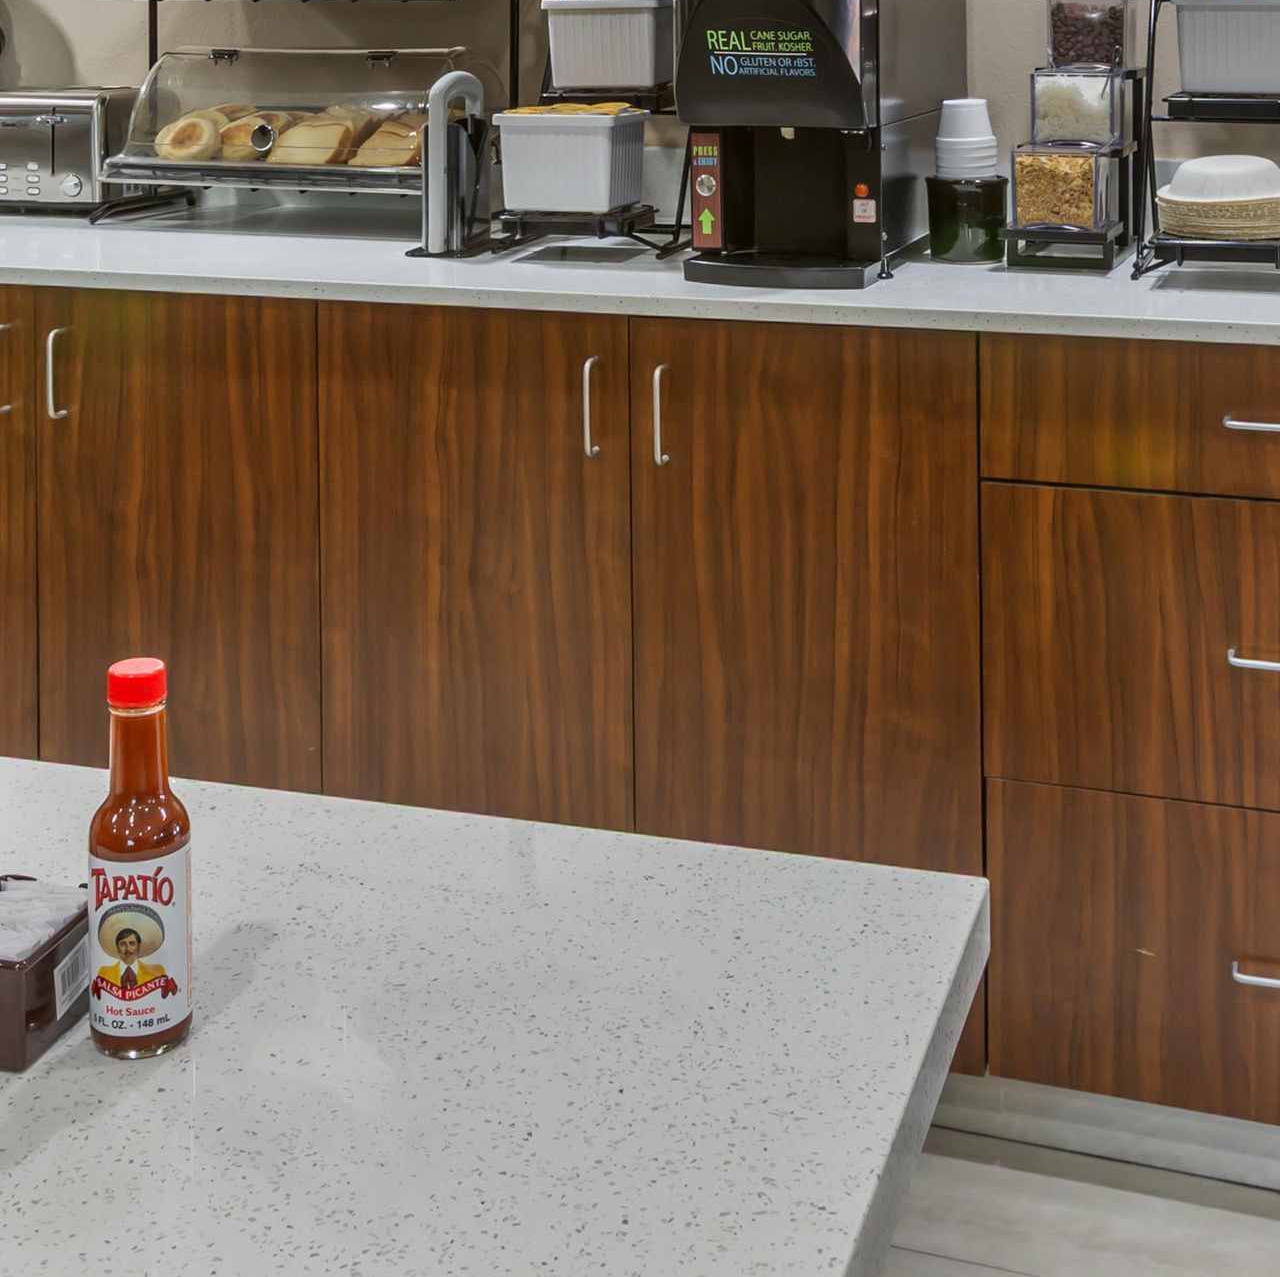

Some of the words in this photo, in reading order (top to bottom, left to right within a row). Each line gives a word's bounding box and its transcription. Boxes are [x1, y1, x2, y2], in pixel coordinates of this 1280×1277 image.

[706, 30, 752, 51] REAL
[750, 30, 776, 40] CANE
[710, 55, 738, 75] NO
[740, 57, 777, 67] GLUTEN
[778, 58, 792, 67] OR
[738, 67, 780, 76] ARTIFICIAL
[692, 146, 718, 156] PRESS
[91, 866, 174, 912] TAPATÍO
[96, 977, 123, 999] SALSA
[125, 976, 168, 1000] PICANTE
[106, 1005, 124, 1016] Hot
[125, 1006, 156, 1017] Sauce
[98, 1016, 109, 1027] FL.
[111, 1020, 127, 1030] OZ.
[136, 1018, 154, 1029] 148
[156, 1014, 171, 1025] mL
